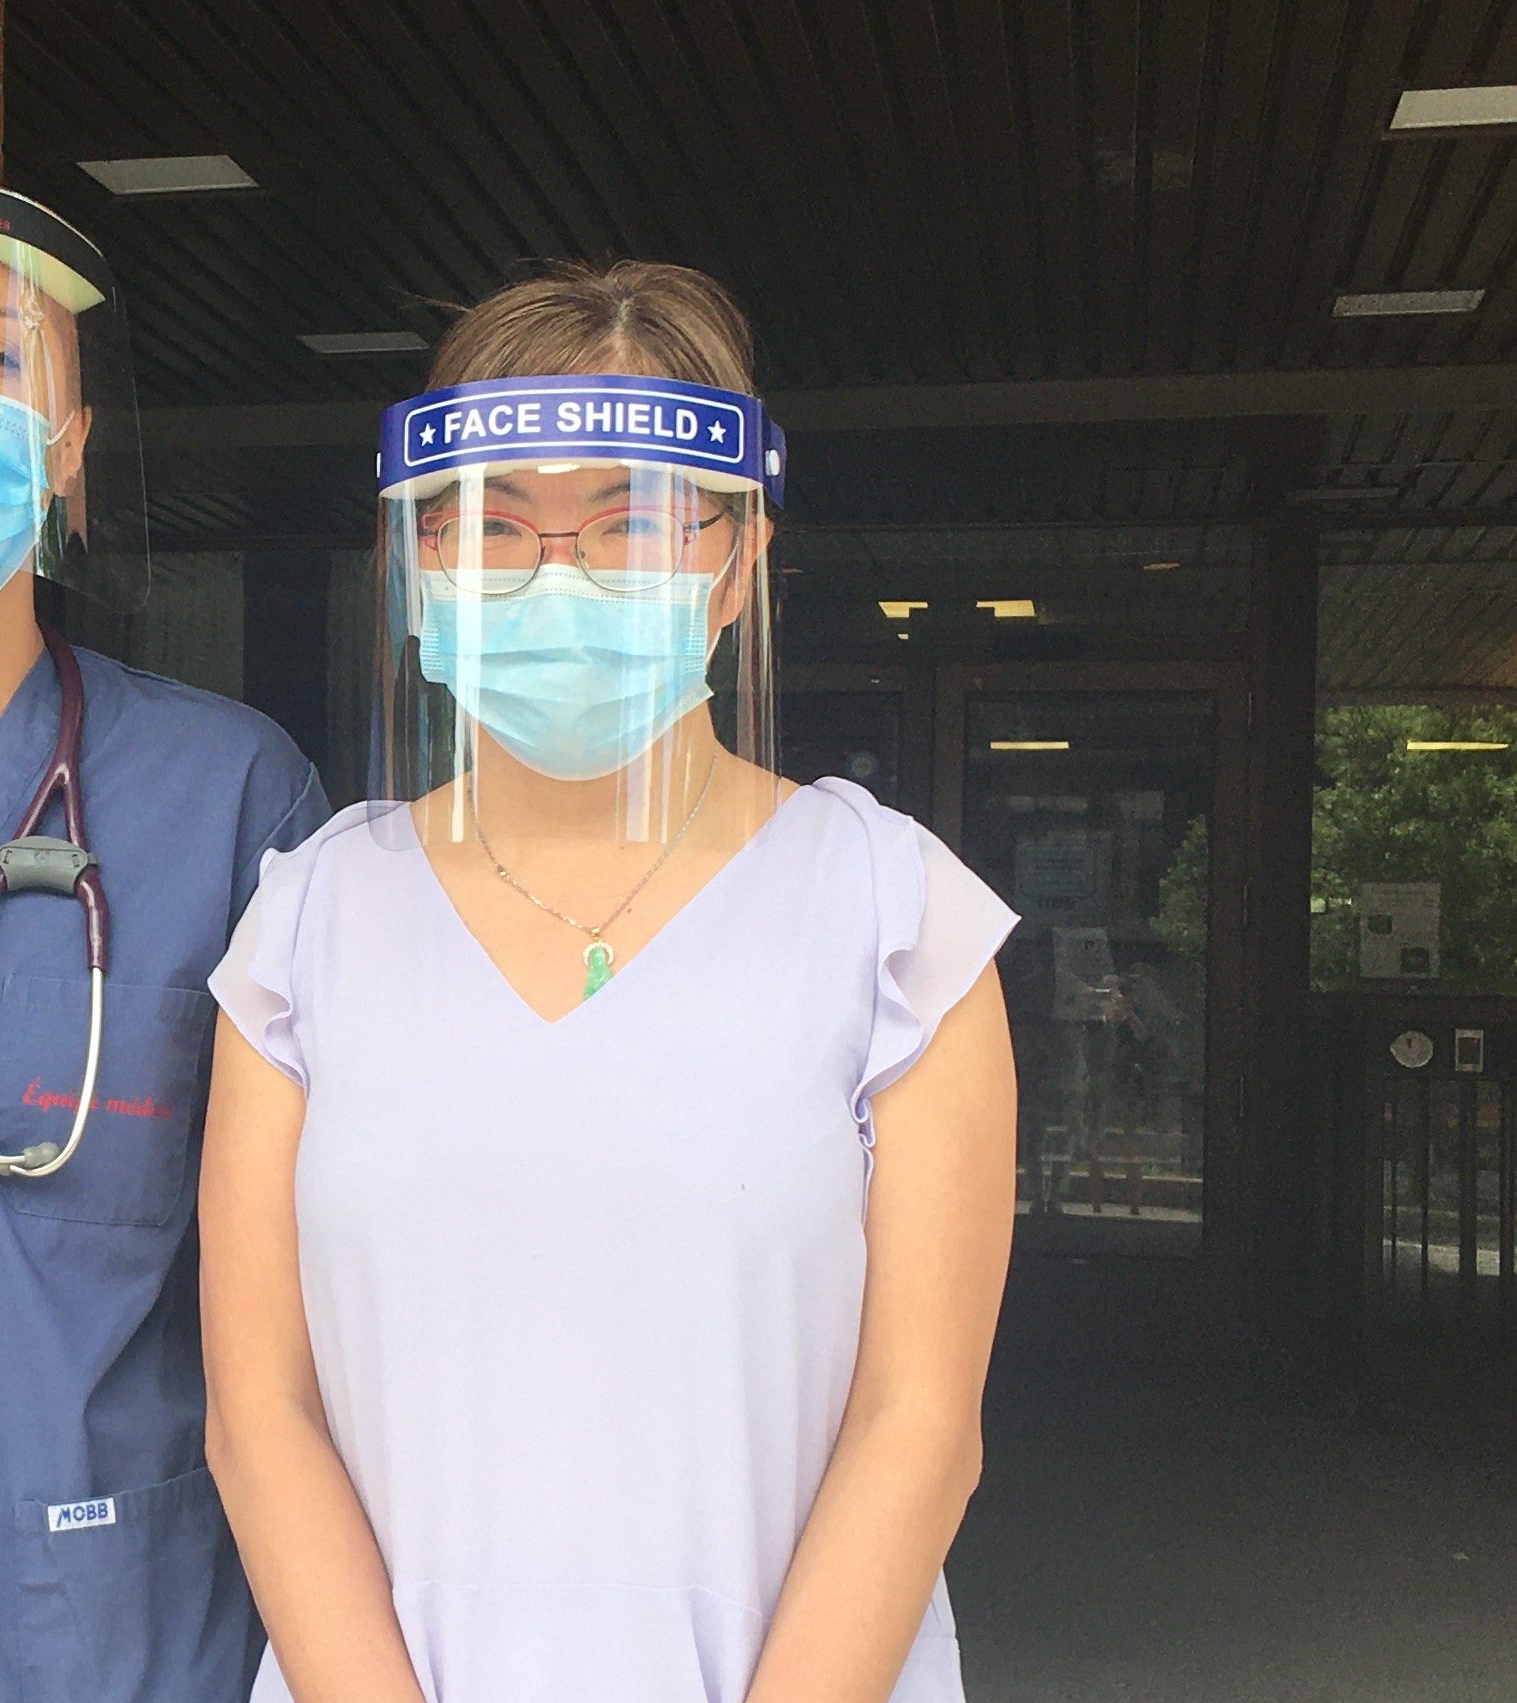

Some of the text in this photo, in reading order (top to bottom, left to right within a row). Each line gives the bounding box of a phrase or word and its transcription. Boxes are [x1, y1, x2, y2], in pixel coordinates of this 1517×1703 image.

[443, 402, 699, 444] FACE SHIELD
[56, 1503, 108, 1528] MOBB
